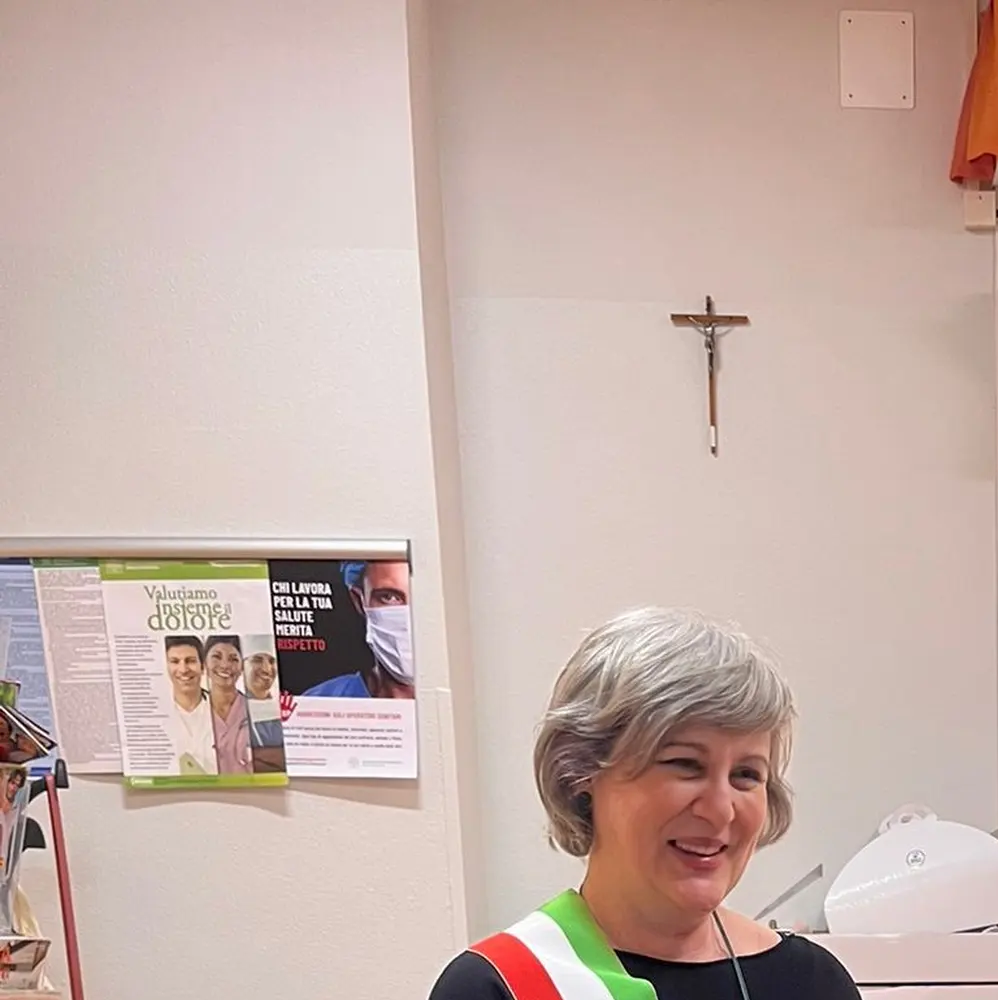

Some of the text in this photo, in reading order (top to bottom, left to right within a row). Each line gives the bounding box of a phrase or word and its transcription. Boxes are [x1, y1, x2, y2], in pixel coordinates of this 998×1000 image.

[143, 584, 218, 600] Valutiamo
[272, 581, 333, 595] CHI LAVORA
[155, 600, 222, 615] insieme
[273, 595, 334, 609] PER LA TUA
[147, 606, 232, 631] dolore
[274, 609, 315, 623] SALUTE
[275, 624, 313, 637] MERITA
[277, 637, 326, 651] RISPETTO
